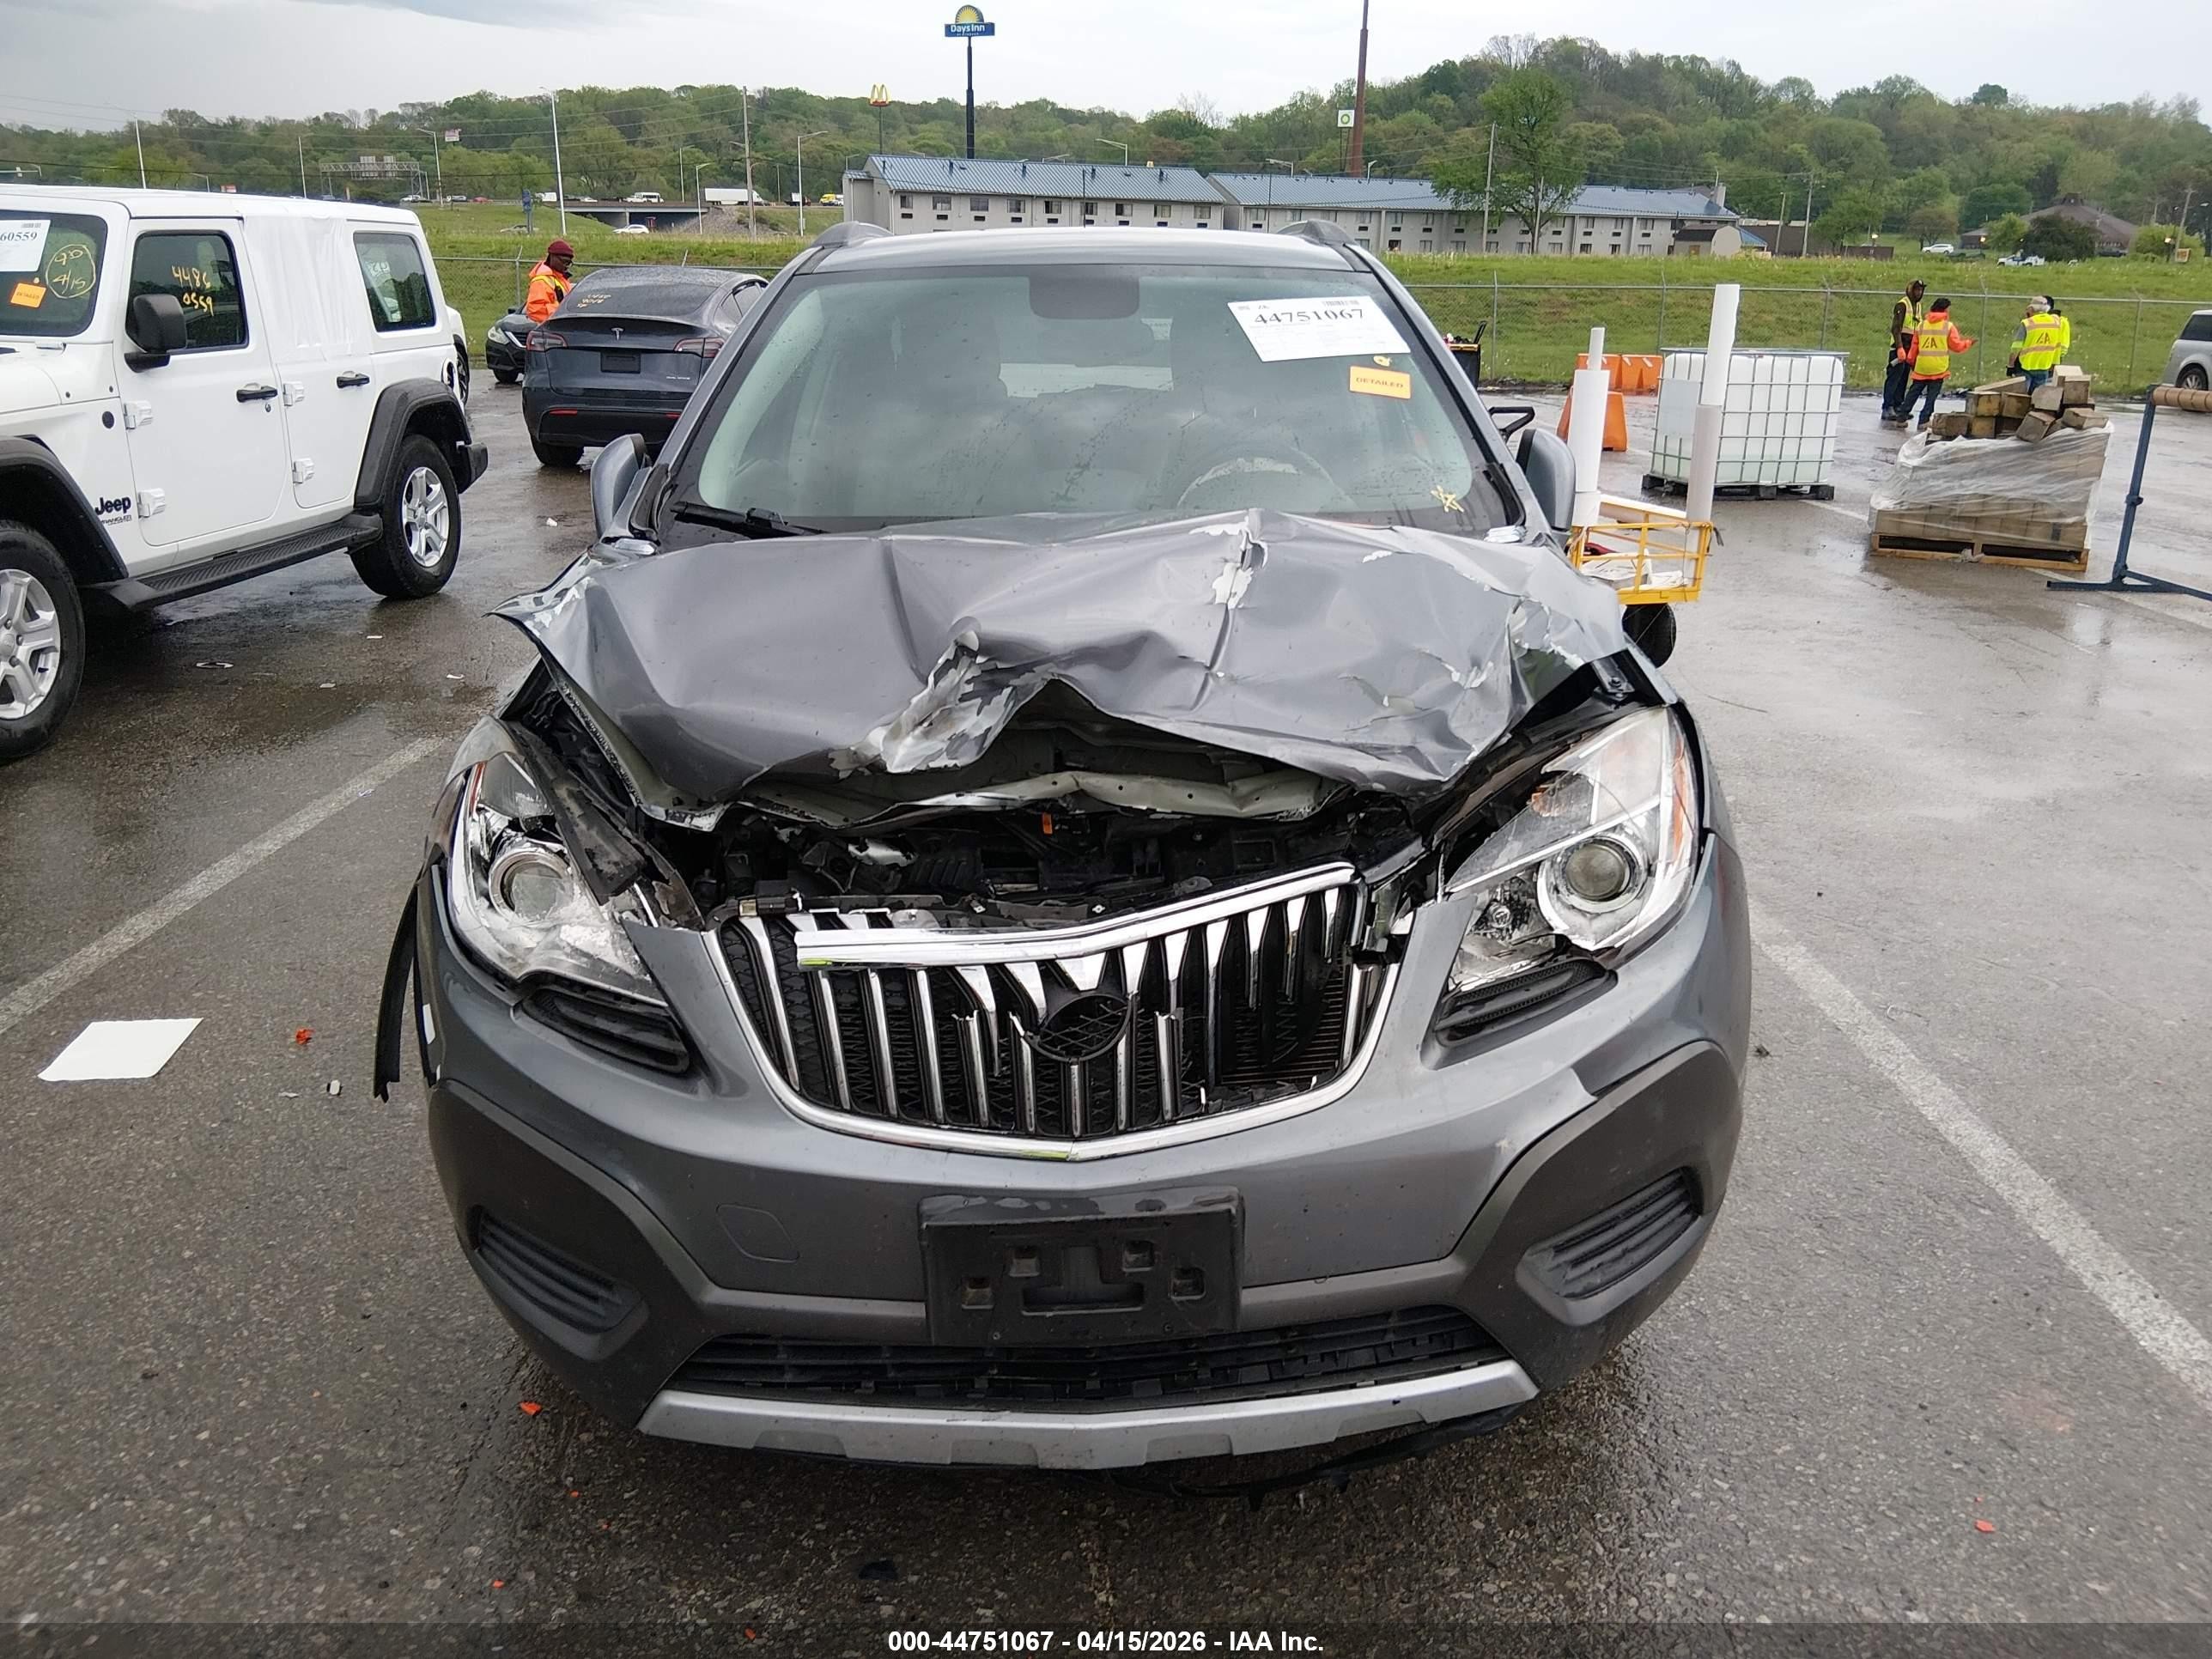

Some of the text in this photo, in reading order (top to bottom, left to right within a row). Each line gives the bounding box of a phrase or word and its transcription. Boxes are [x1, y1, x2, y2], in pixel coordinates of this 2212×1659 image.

[182, 292, 215, 317] 0559
[1254, 308, 1363, 324] 44751067
[1356, 377, 1404, 389] DETAILED
[95, 496, 131, 515] Jeep
